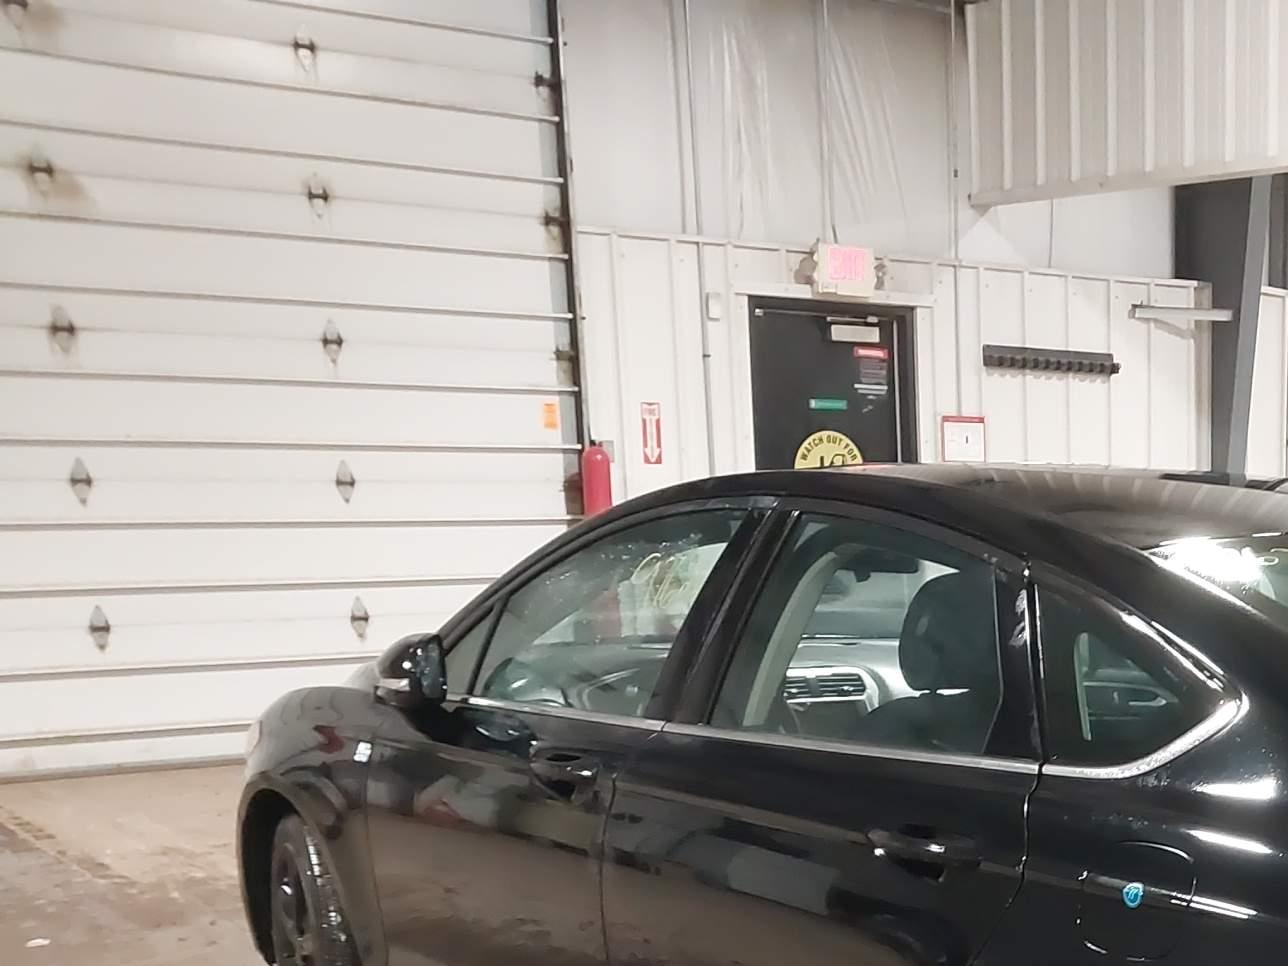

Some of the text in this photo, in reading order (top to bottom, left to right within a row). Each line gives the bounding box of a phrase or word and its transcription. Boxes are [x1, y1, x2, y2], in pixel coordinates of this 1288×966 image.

[800, 434, 859, 462] WATCH OUT FOR
